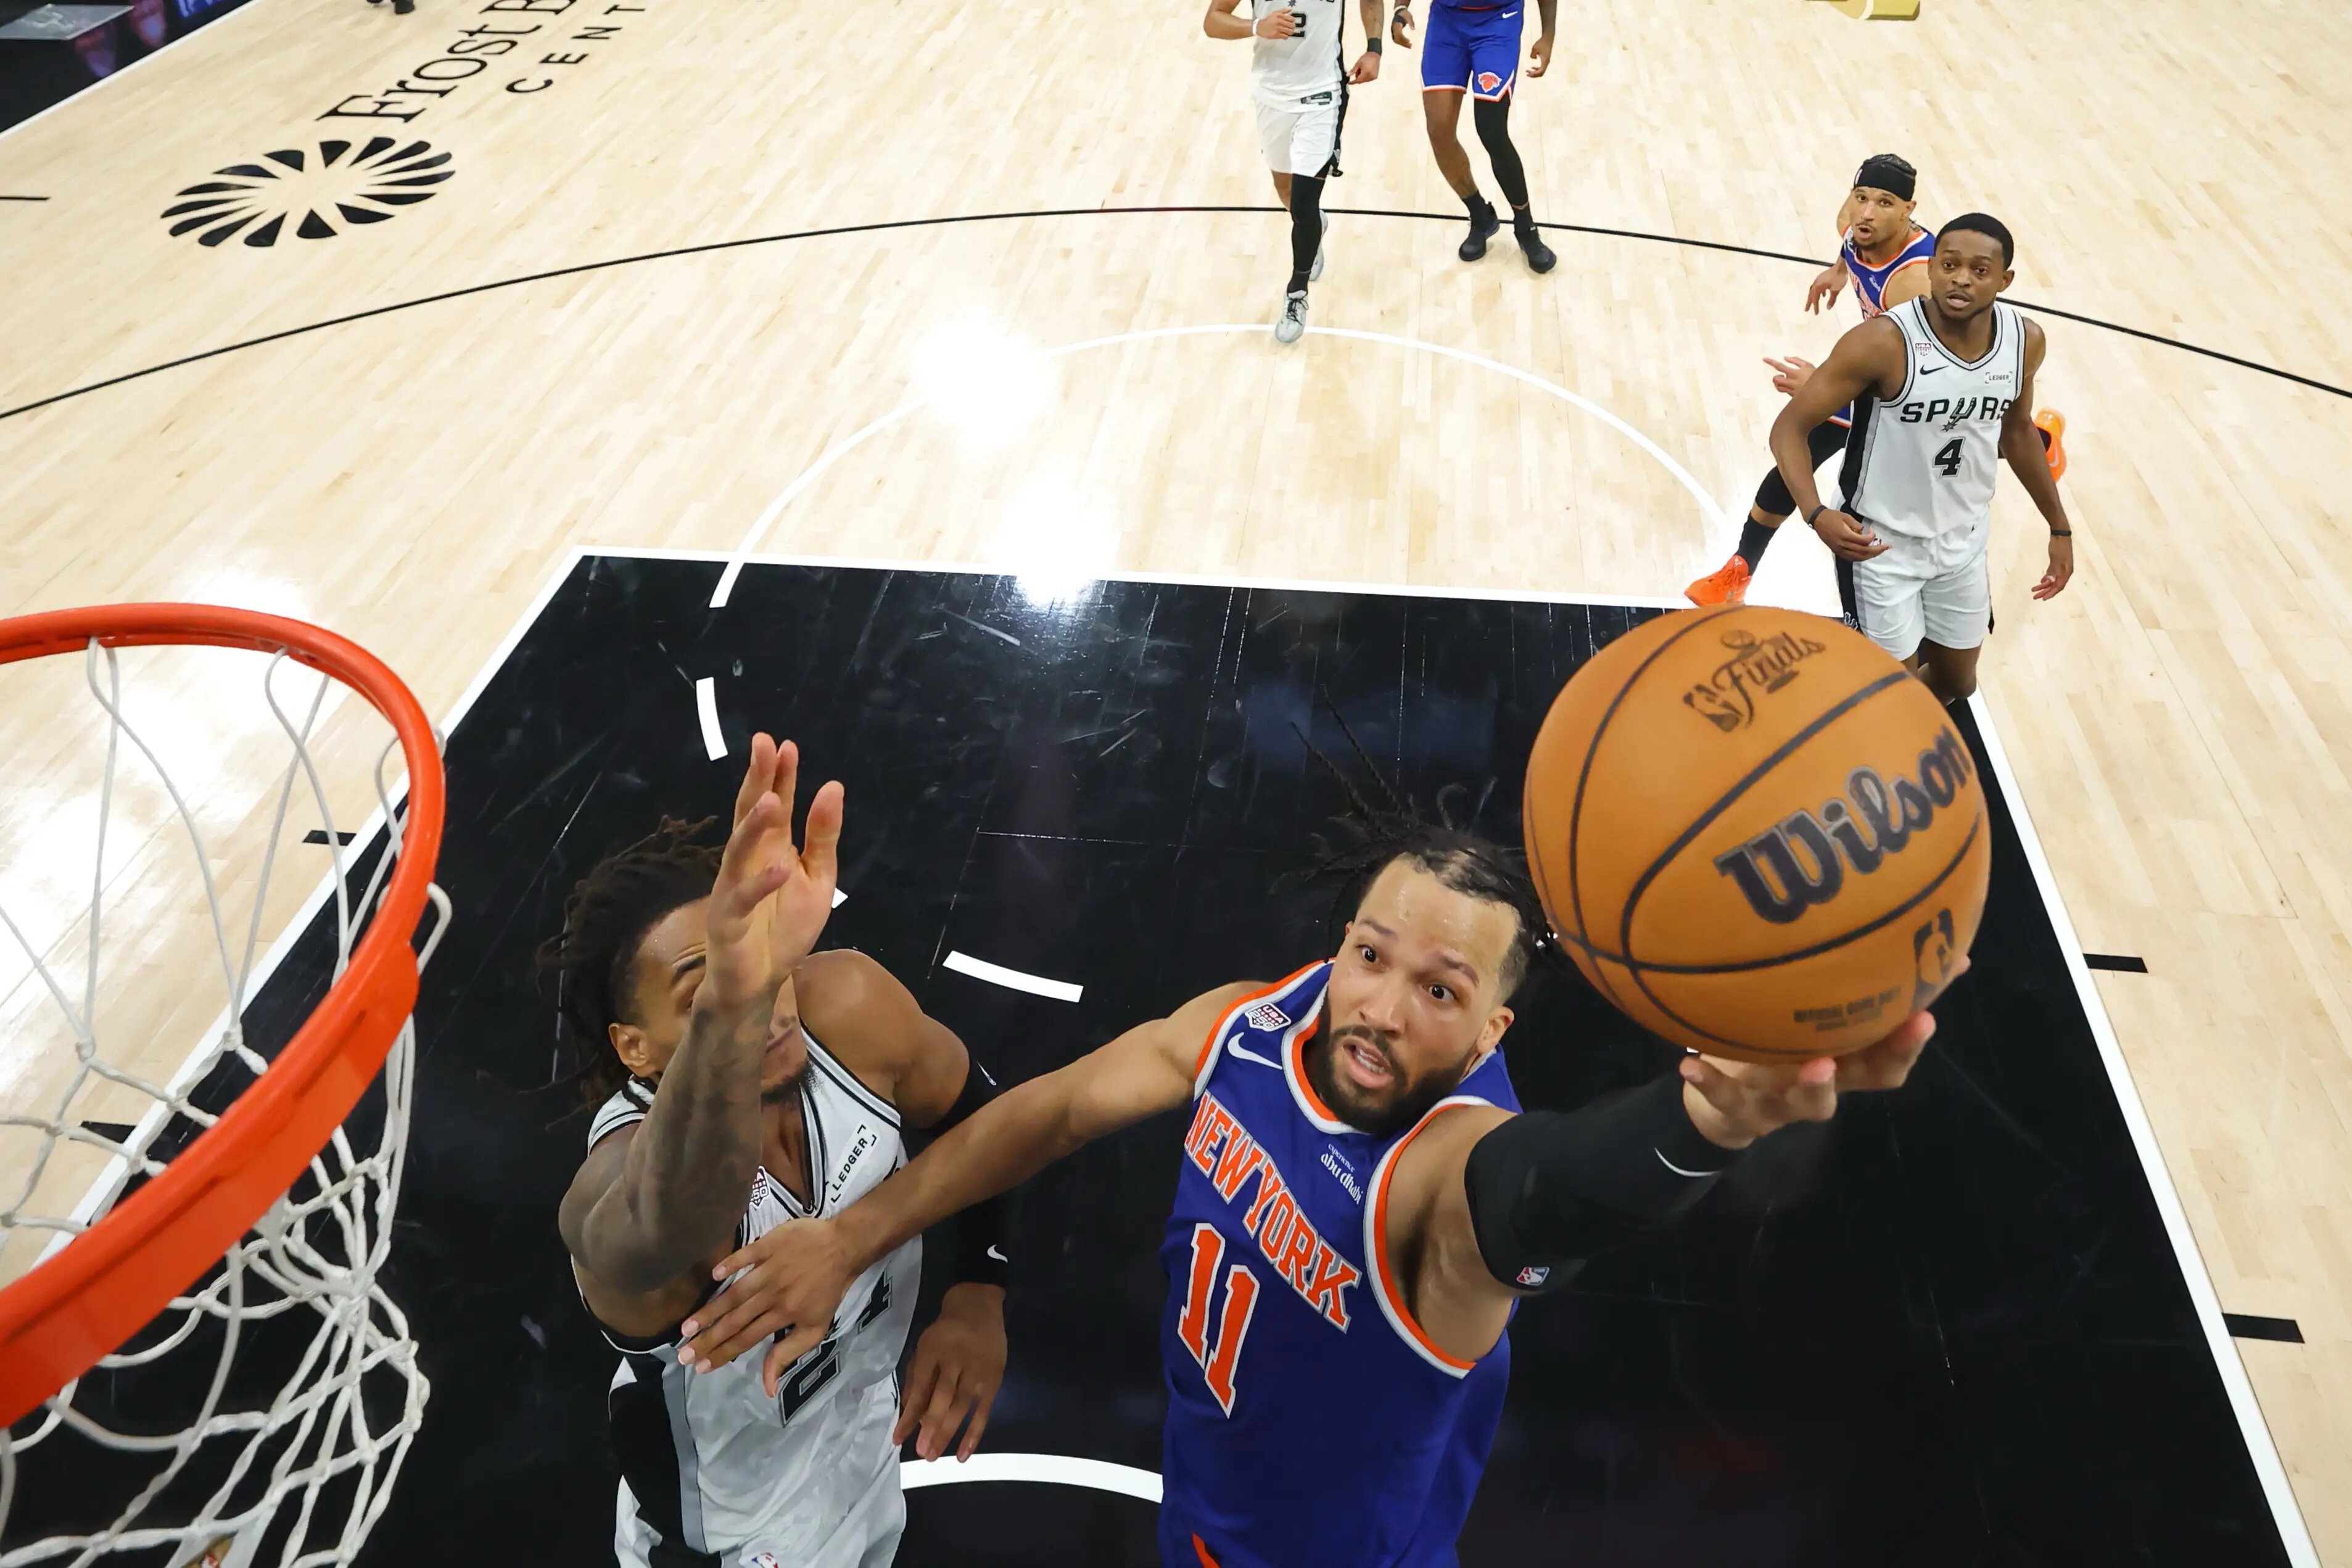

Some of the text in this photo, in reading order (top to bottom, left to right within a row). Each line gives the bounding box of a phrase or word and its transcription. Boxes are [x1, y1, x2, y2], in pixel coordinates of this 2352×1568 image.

[315, 24, 542, 123] Frost
[1933, 436, 1966, 478] 4
[1711, 630, 1827, 729] Finals
[1713, 724, 1973, 924] Wilson
[1248, 1010, 1275, 1029] 250
[1262, 1005, 1284, 1023] USA
[831, 1137, 868, 1191] LEDGER
[1184, 1089, 1264, 1205] NEW
[1328, 1143, 1355, 1173] experience
[751, 1186, 769, 1200] 50
[1321, 1153, 1364, 1205] abu dhabi
[1242, 1157, 1363, 1334] YORK
[1178, 1223, 1260, 1419] 11
